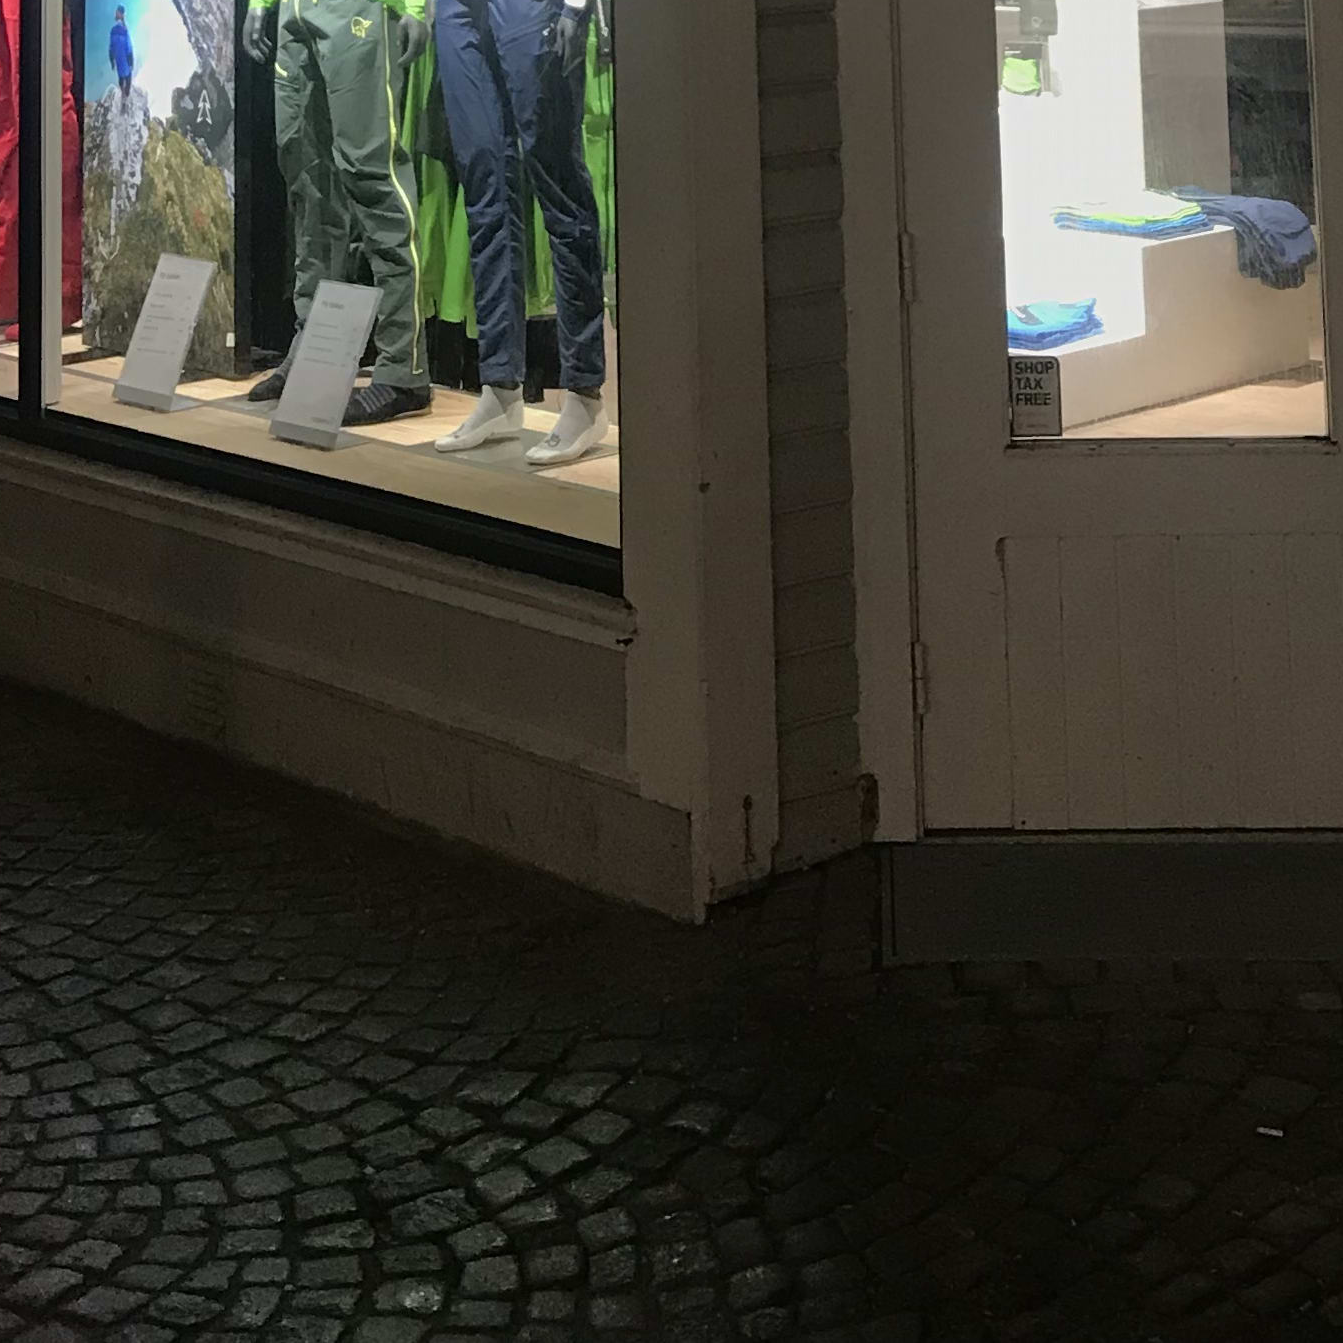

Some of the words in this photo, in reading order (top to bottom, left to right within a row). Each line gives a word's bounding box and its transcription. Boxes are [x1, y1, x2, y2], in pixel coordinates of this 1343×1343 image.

[1014, 361, 1055, 375] SHOP
[1015, 377, 1044, 390] TAX
[1015, 392, 1052, 406] FREE
